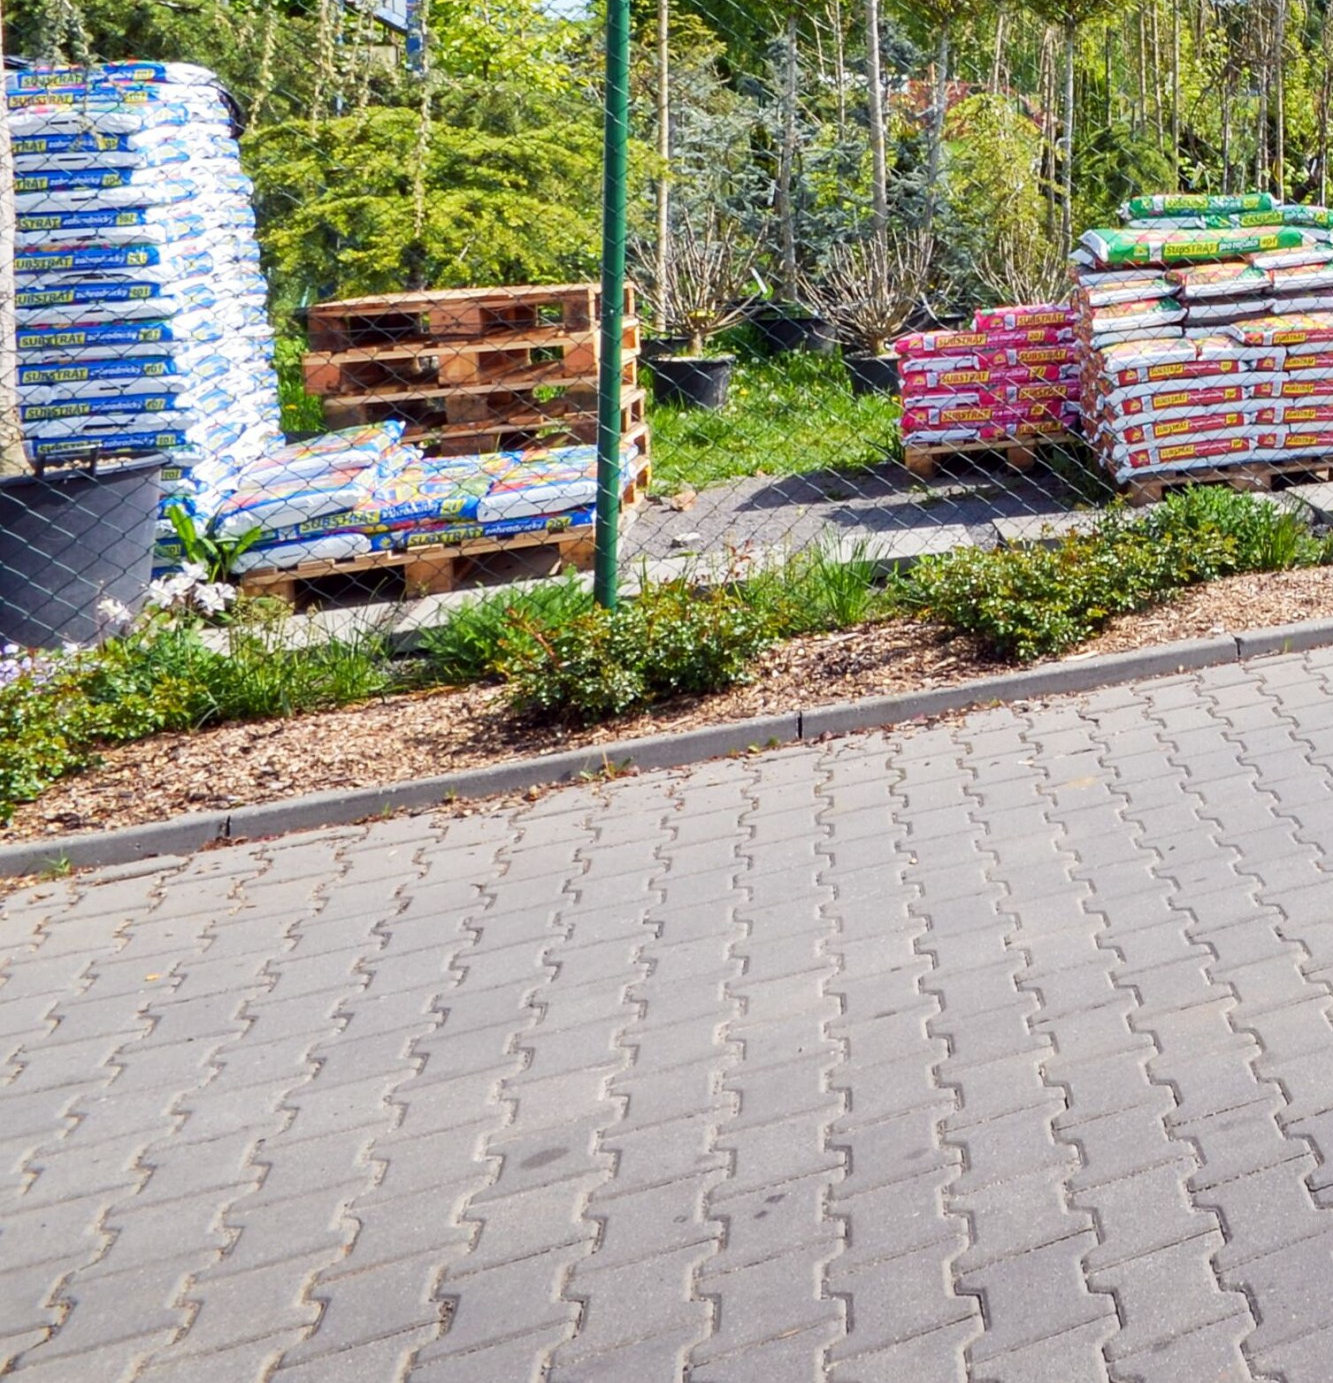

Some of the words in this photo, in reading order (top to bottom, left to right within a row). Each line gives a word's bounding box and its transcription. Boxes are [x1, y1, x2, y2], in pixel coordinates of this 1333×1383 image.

[1165, 243, 1216, 255] SUBSTRAT
[22, 332, 85, 347] SUBSTRAT
[25, 369, 87, 383] SUBSTRAT
[27, 404, 89, 419] SUBSTRAT
